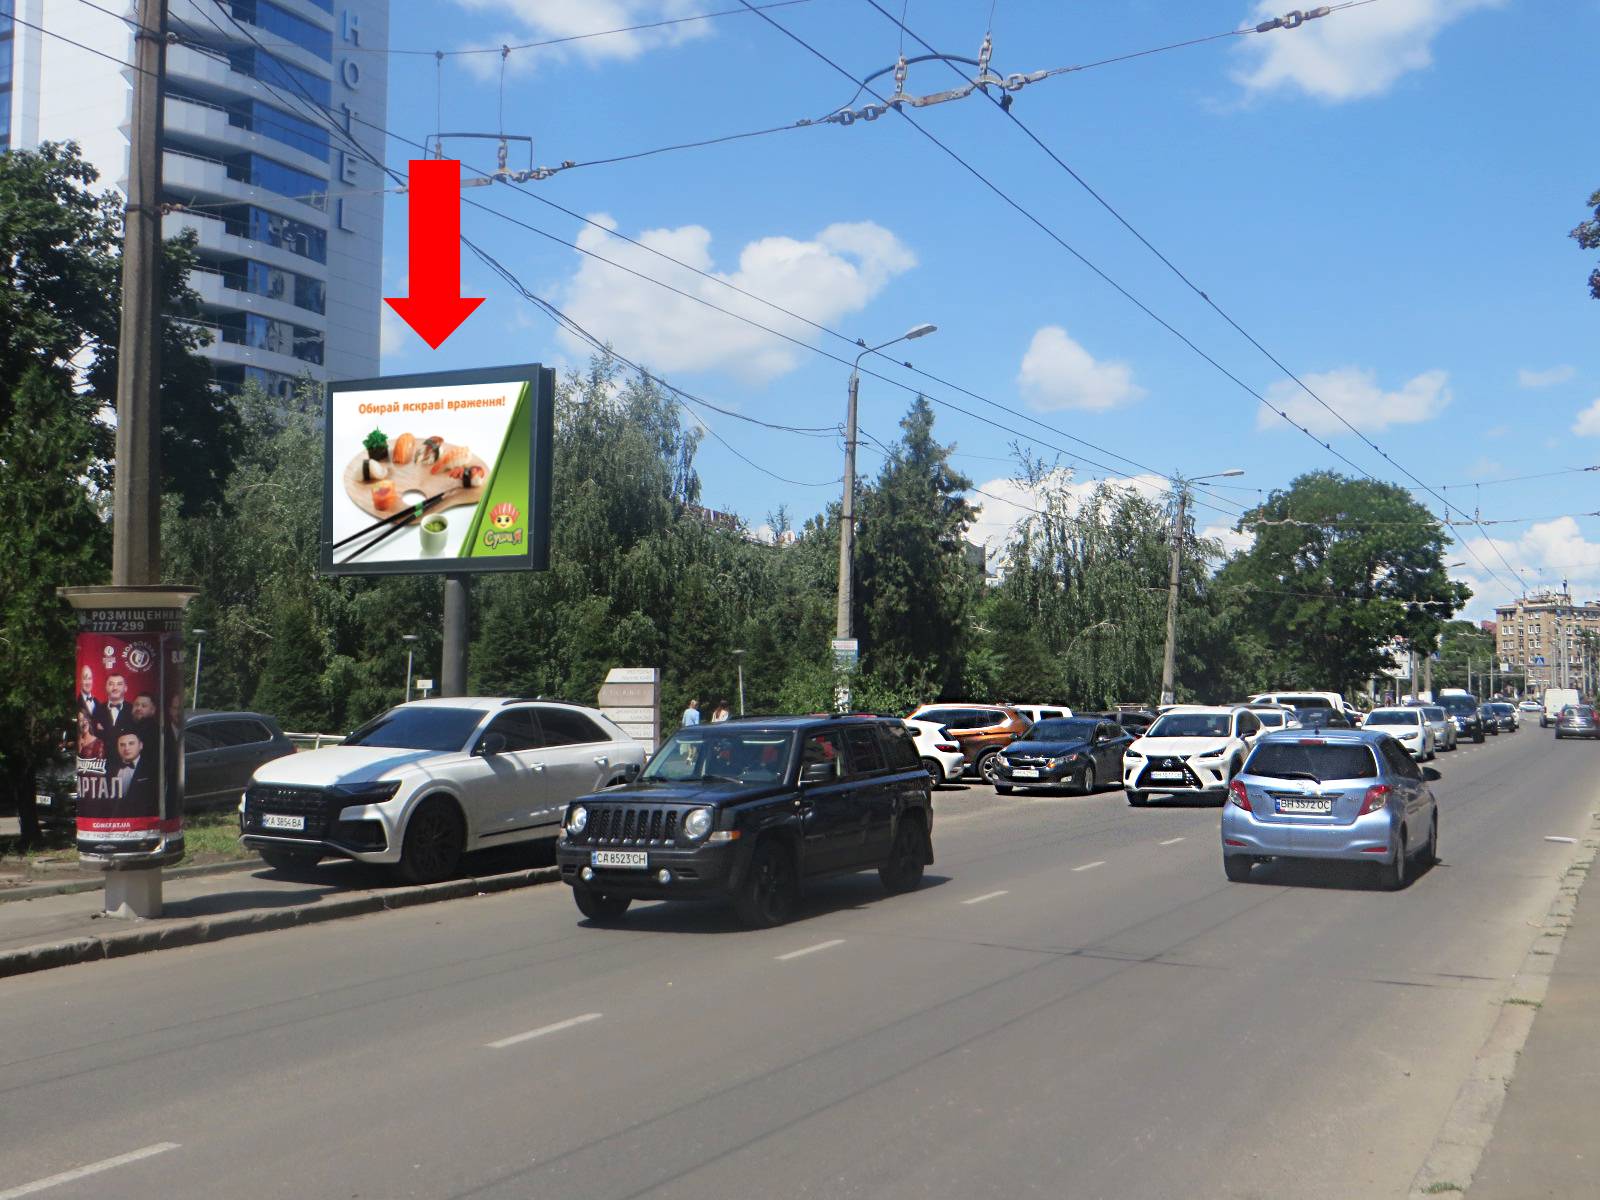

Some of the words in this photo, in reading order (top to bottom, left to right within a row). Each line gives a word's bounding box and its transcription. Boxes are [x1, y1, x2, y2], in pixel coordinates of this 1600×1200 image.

[338, 8, 361, 234] HOTEL
[358, 402, 399, 415] Обирай
[402, 399, 444, 413] яскраві
[447, 396, 506, 411] враження!
